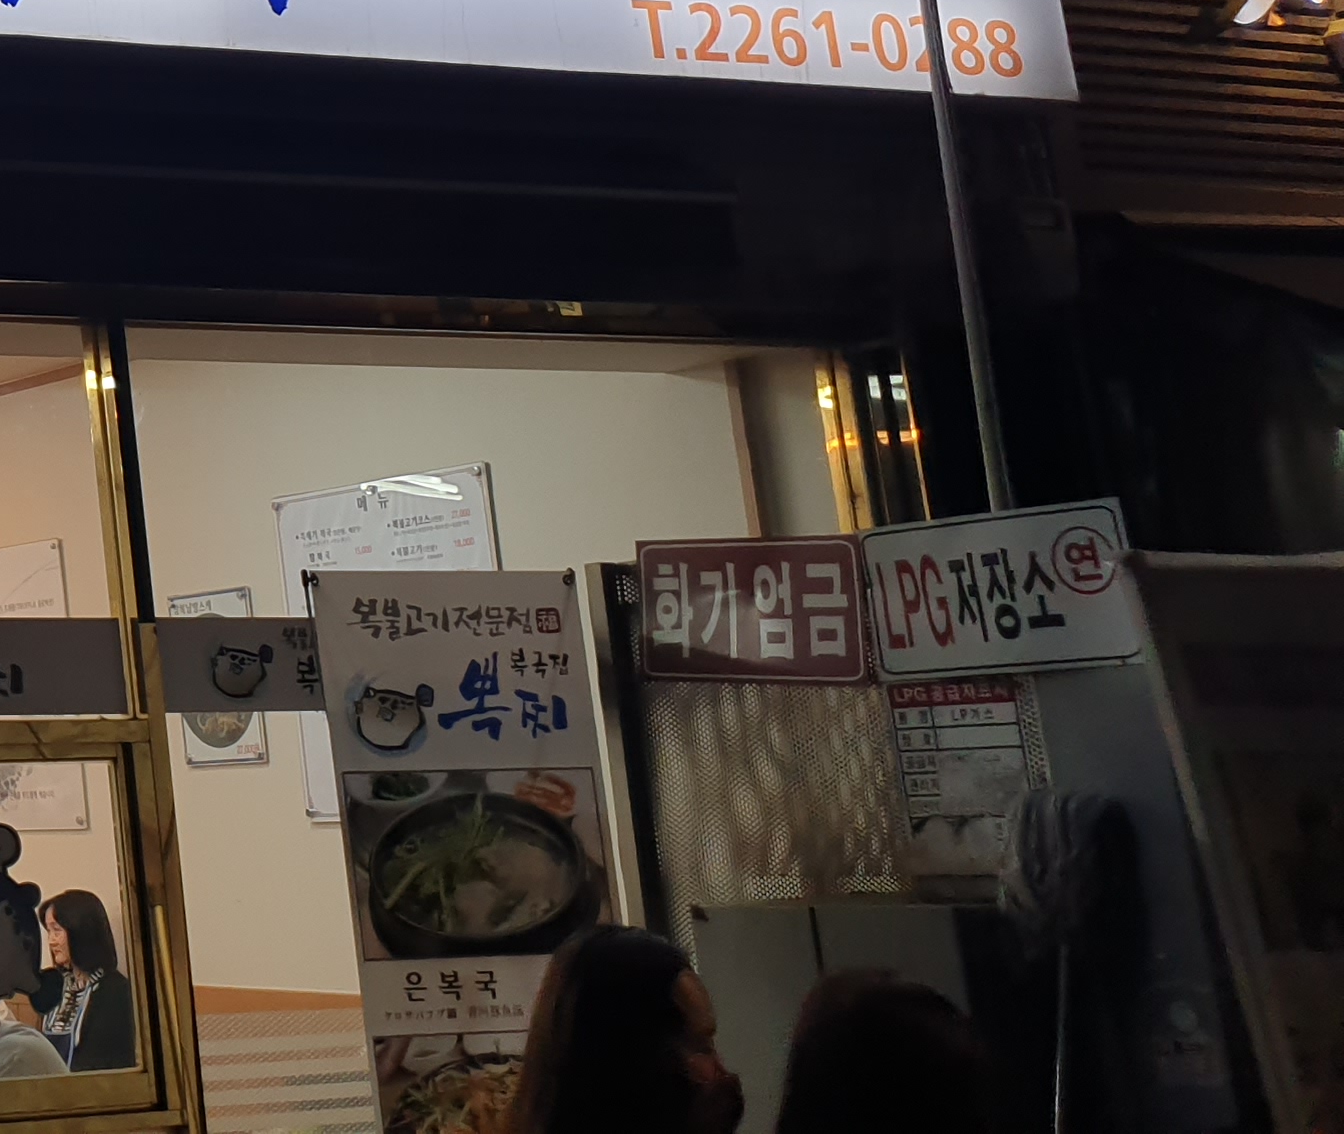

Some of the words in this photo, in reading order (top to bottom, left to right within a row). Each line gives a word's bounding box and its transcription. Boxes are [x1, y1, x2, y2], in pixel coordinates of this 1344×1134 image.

[347, 597, 533, 642] 복불고기전문점
[651, 559, 850, 660] 화기엄금
[510, 647, 570, 680] 복국집
